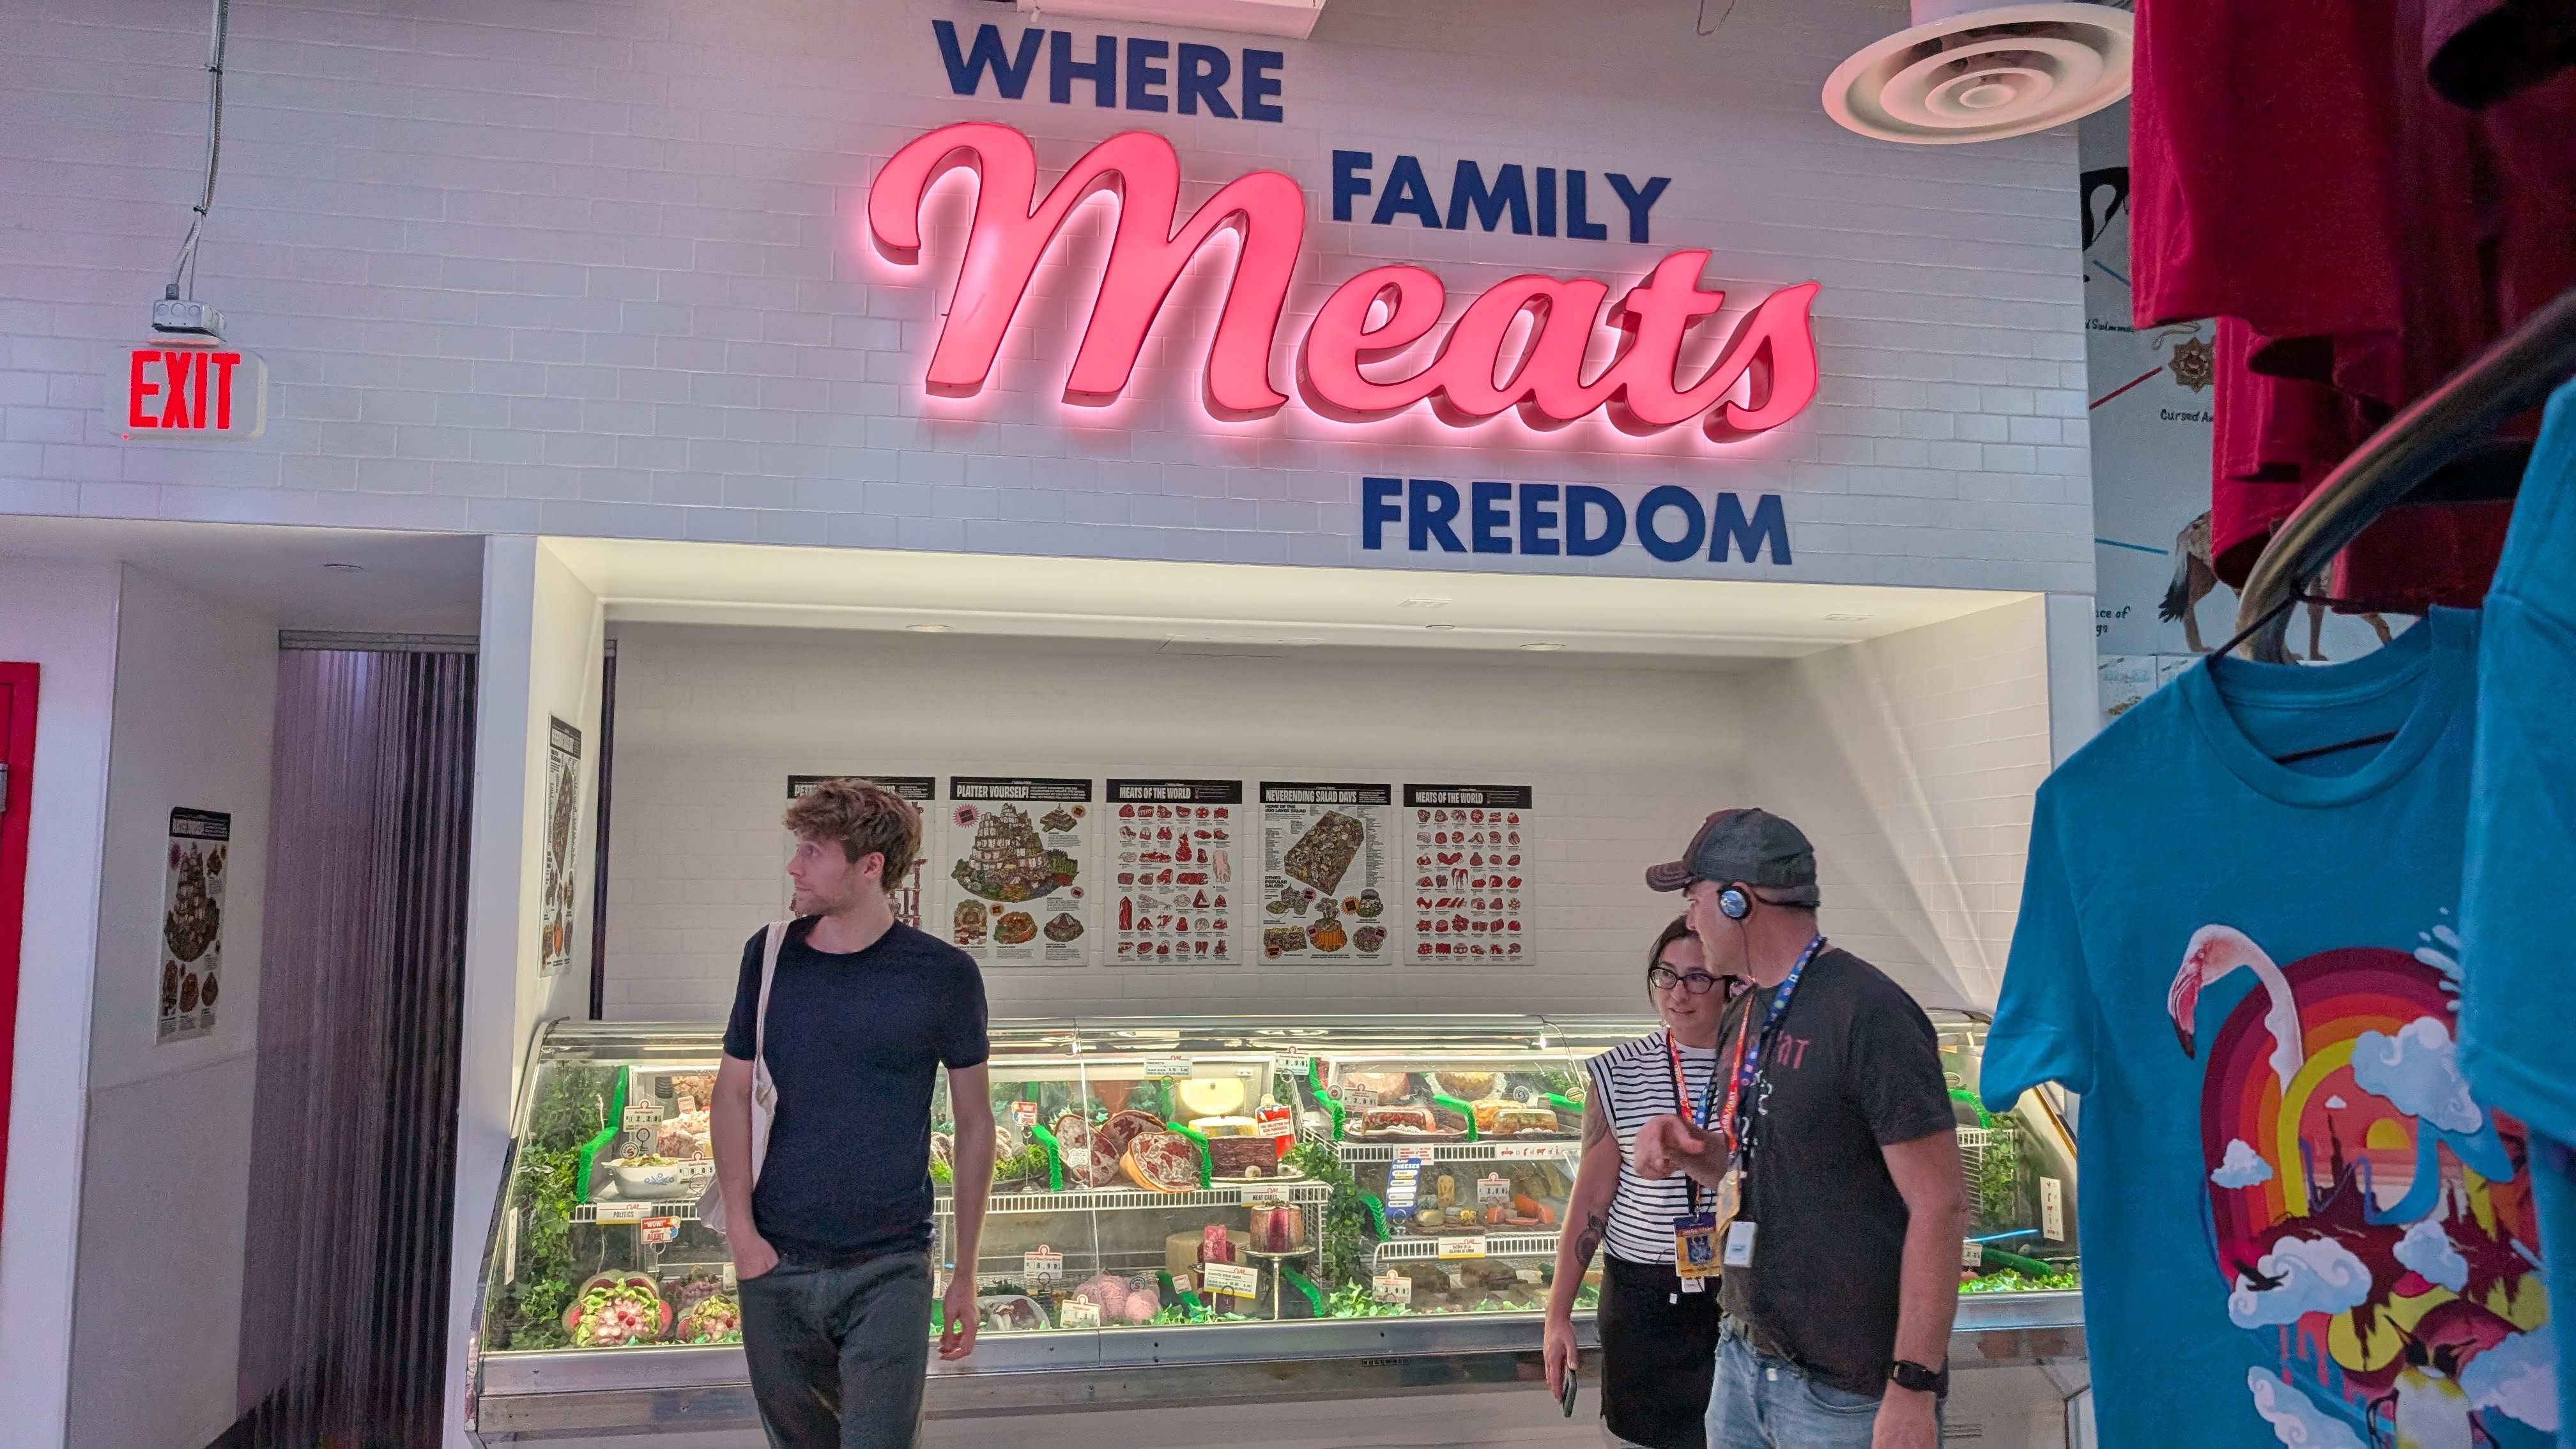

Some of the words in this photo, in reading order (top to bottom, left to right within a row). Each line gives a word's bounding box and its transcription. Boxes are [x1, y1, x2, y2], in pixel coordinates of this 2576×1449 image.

[935, 22, 1282, 121] WHERE
[1333, 151, 1669, 241] FAMILY
[868, 122, 1820, 443] Meats
[128, 349, 241, 431] EXIT
[2160, 409, 2200, 422] Cursed
[1363, 478, 1791, 564] FREEDOM
[2115, 606, 2130, 618] of
[956, 785, 988, 798] PLATTER
[990, 785, 1029, 799] YOURSELF!
[1119, 787, 1142, 799] MEATS
[1143, 787, 1153, 799] OF
[1153, 787, 1166, 799] THE
[1167, 787, 1192, 799] WORLD
[1266, 790, 1314, 802] NEVERENDING
[1315, 791, 1338, 802] SALAD
[1338, 791, 1357, 803] DAYS
[1415, 792, 1438, 803] MEATS
[1438, 792, 1447, 803] OF
[1447, 792, 1460, 804] THE
[1460, 792, 1483, 804] WORLD
